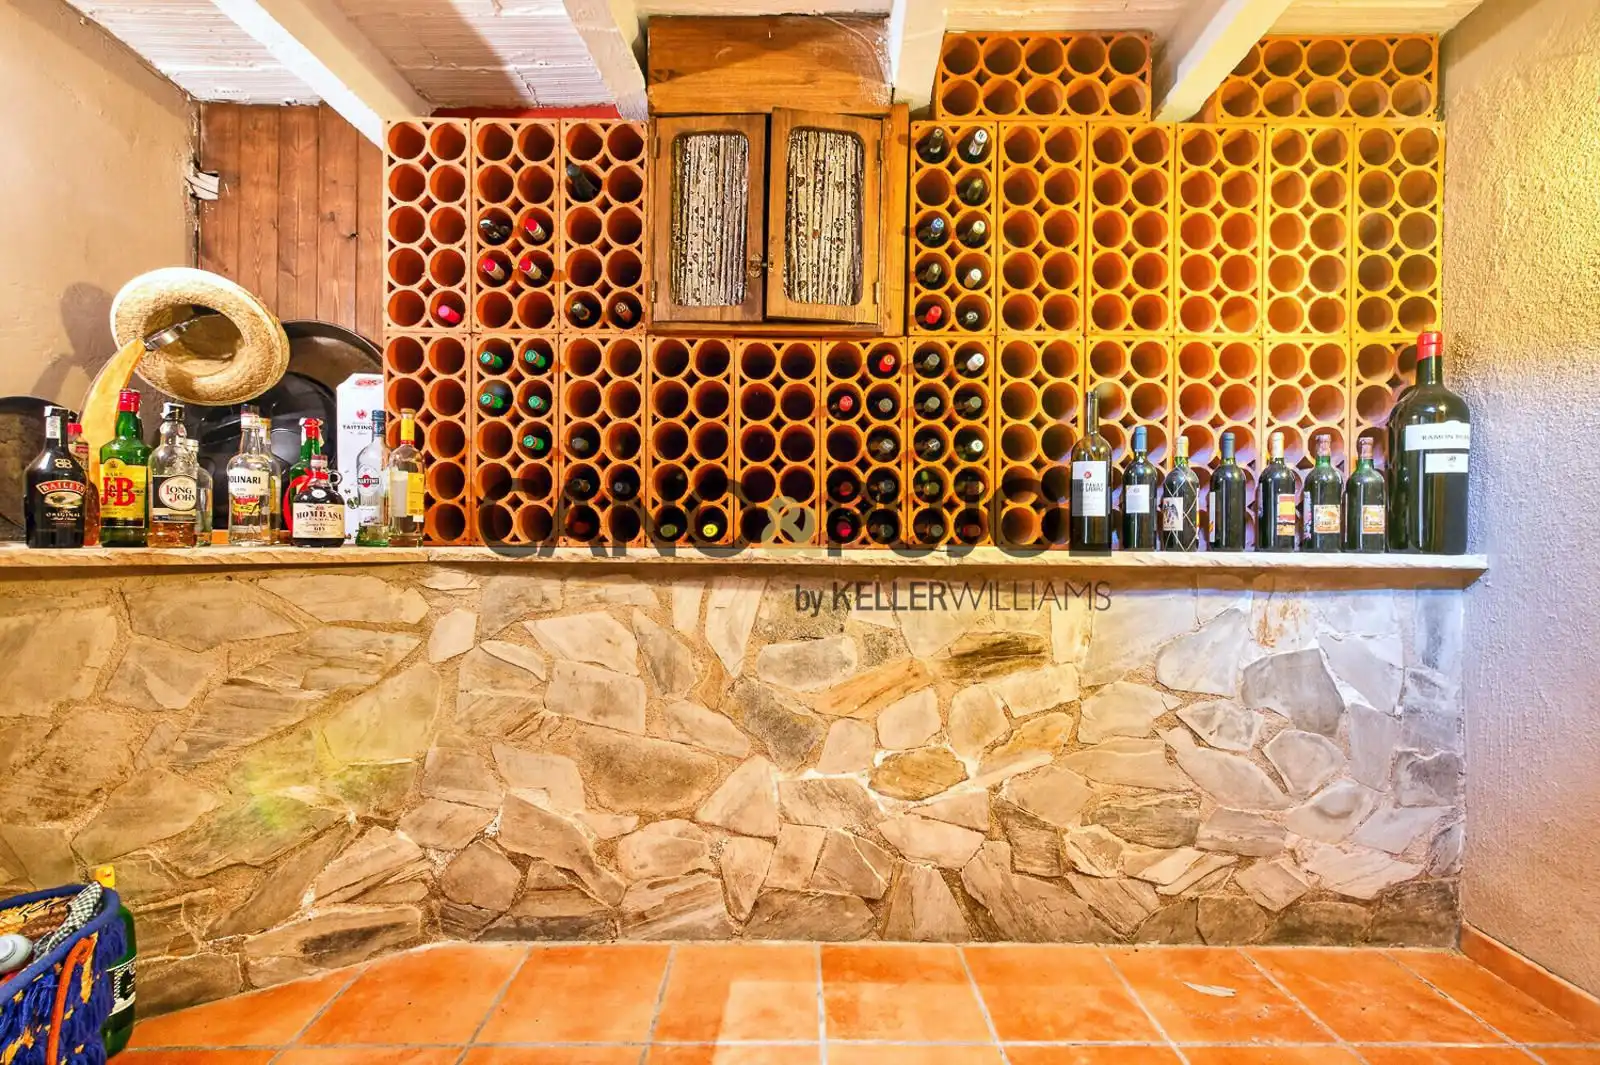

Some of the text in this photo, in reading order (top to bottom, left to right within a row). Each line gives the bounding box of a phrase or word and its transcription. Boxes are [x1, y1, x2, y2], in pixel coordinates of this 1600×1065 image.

[40, 480, 86, 492] BAILEYS
[100, 476, 136, 507] J&B
[165, 485, 193, 496] LONG
